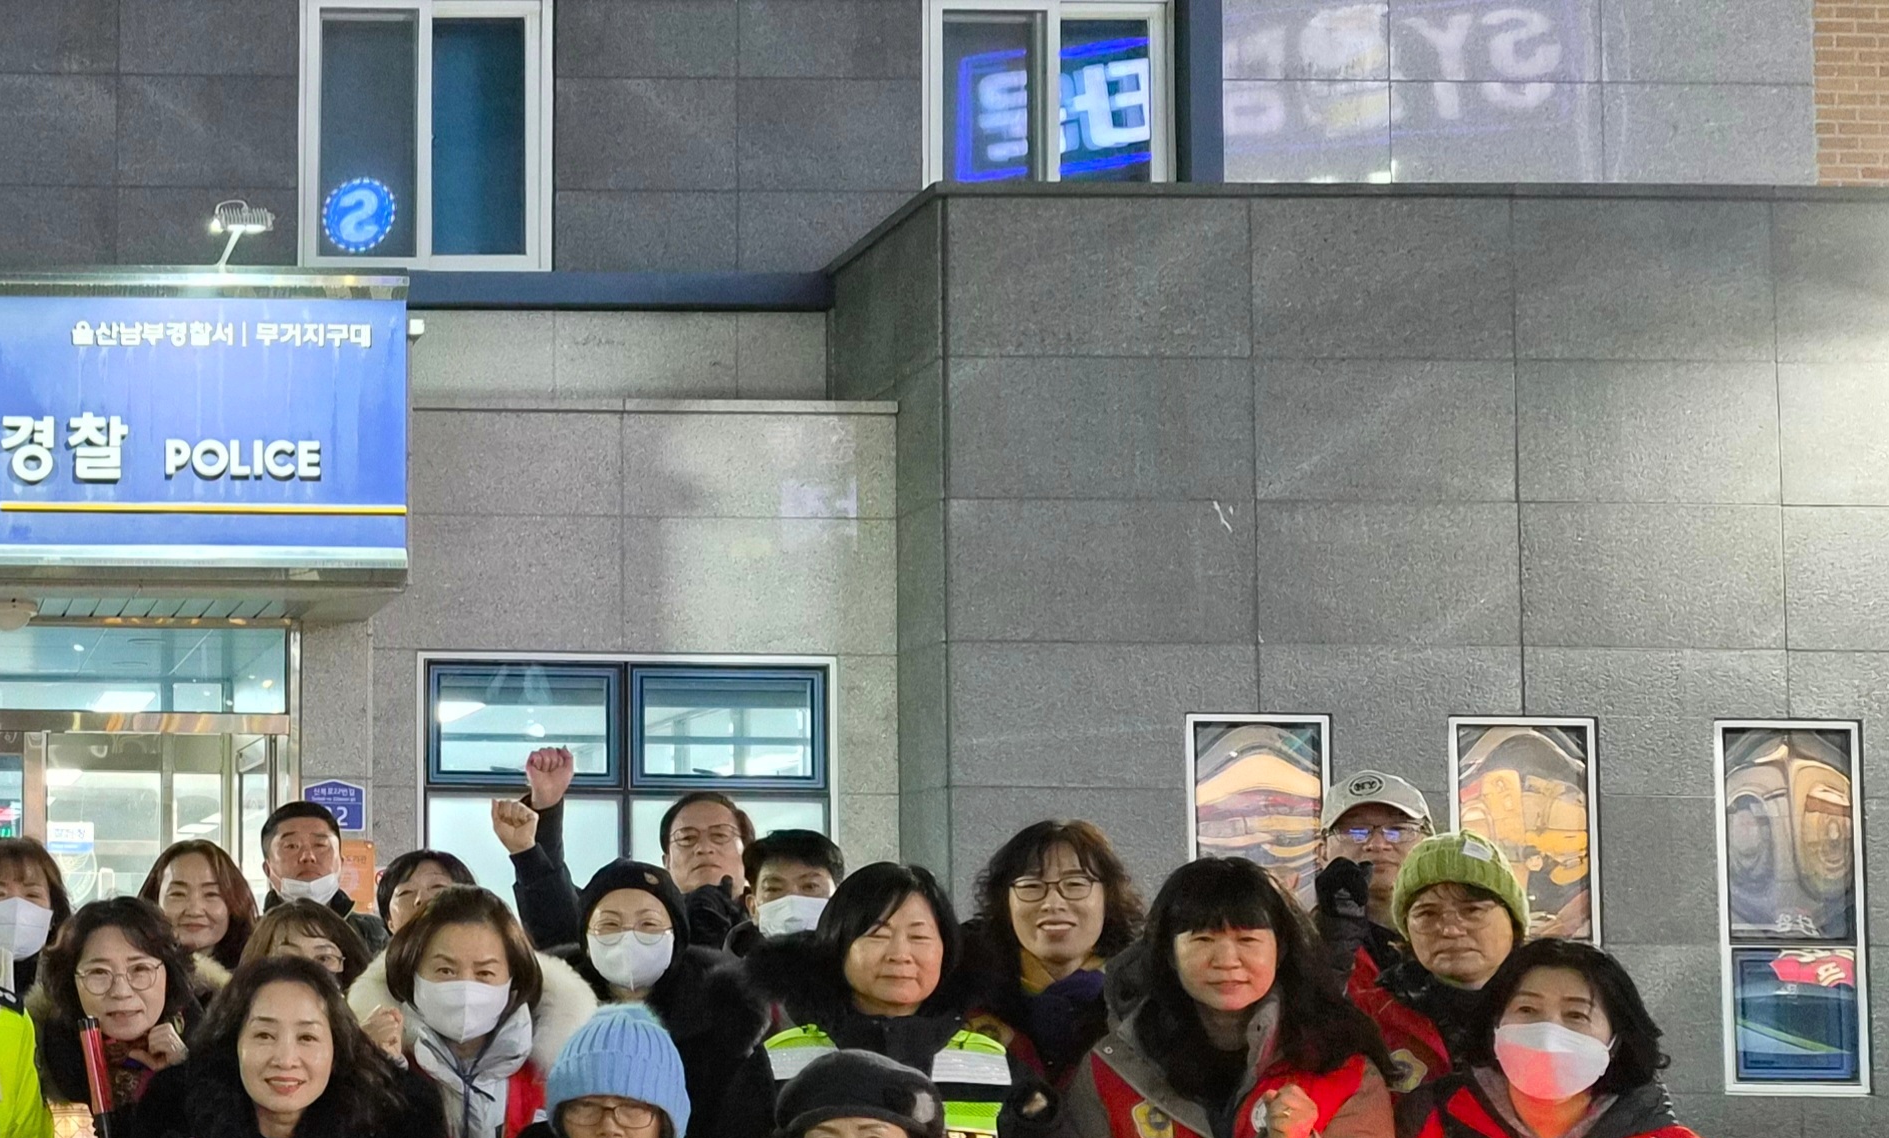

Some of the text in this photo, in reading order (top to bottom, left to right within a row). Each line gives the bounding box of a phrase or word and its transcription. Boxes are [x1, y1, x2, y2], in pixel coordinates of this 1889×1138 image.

[71, 320, 371, 347] 울산남부경찰서 무거지구대
[0, 411, 321, 482] 경찰 POLICE
[325, 805, 349, 827] 2
